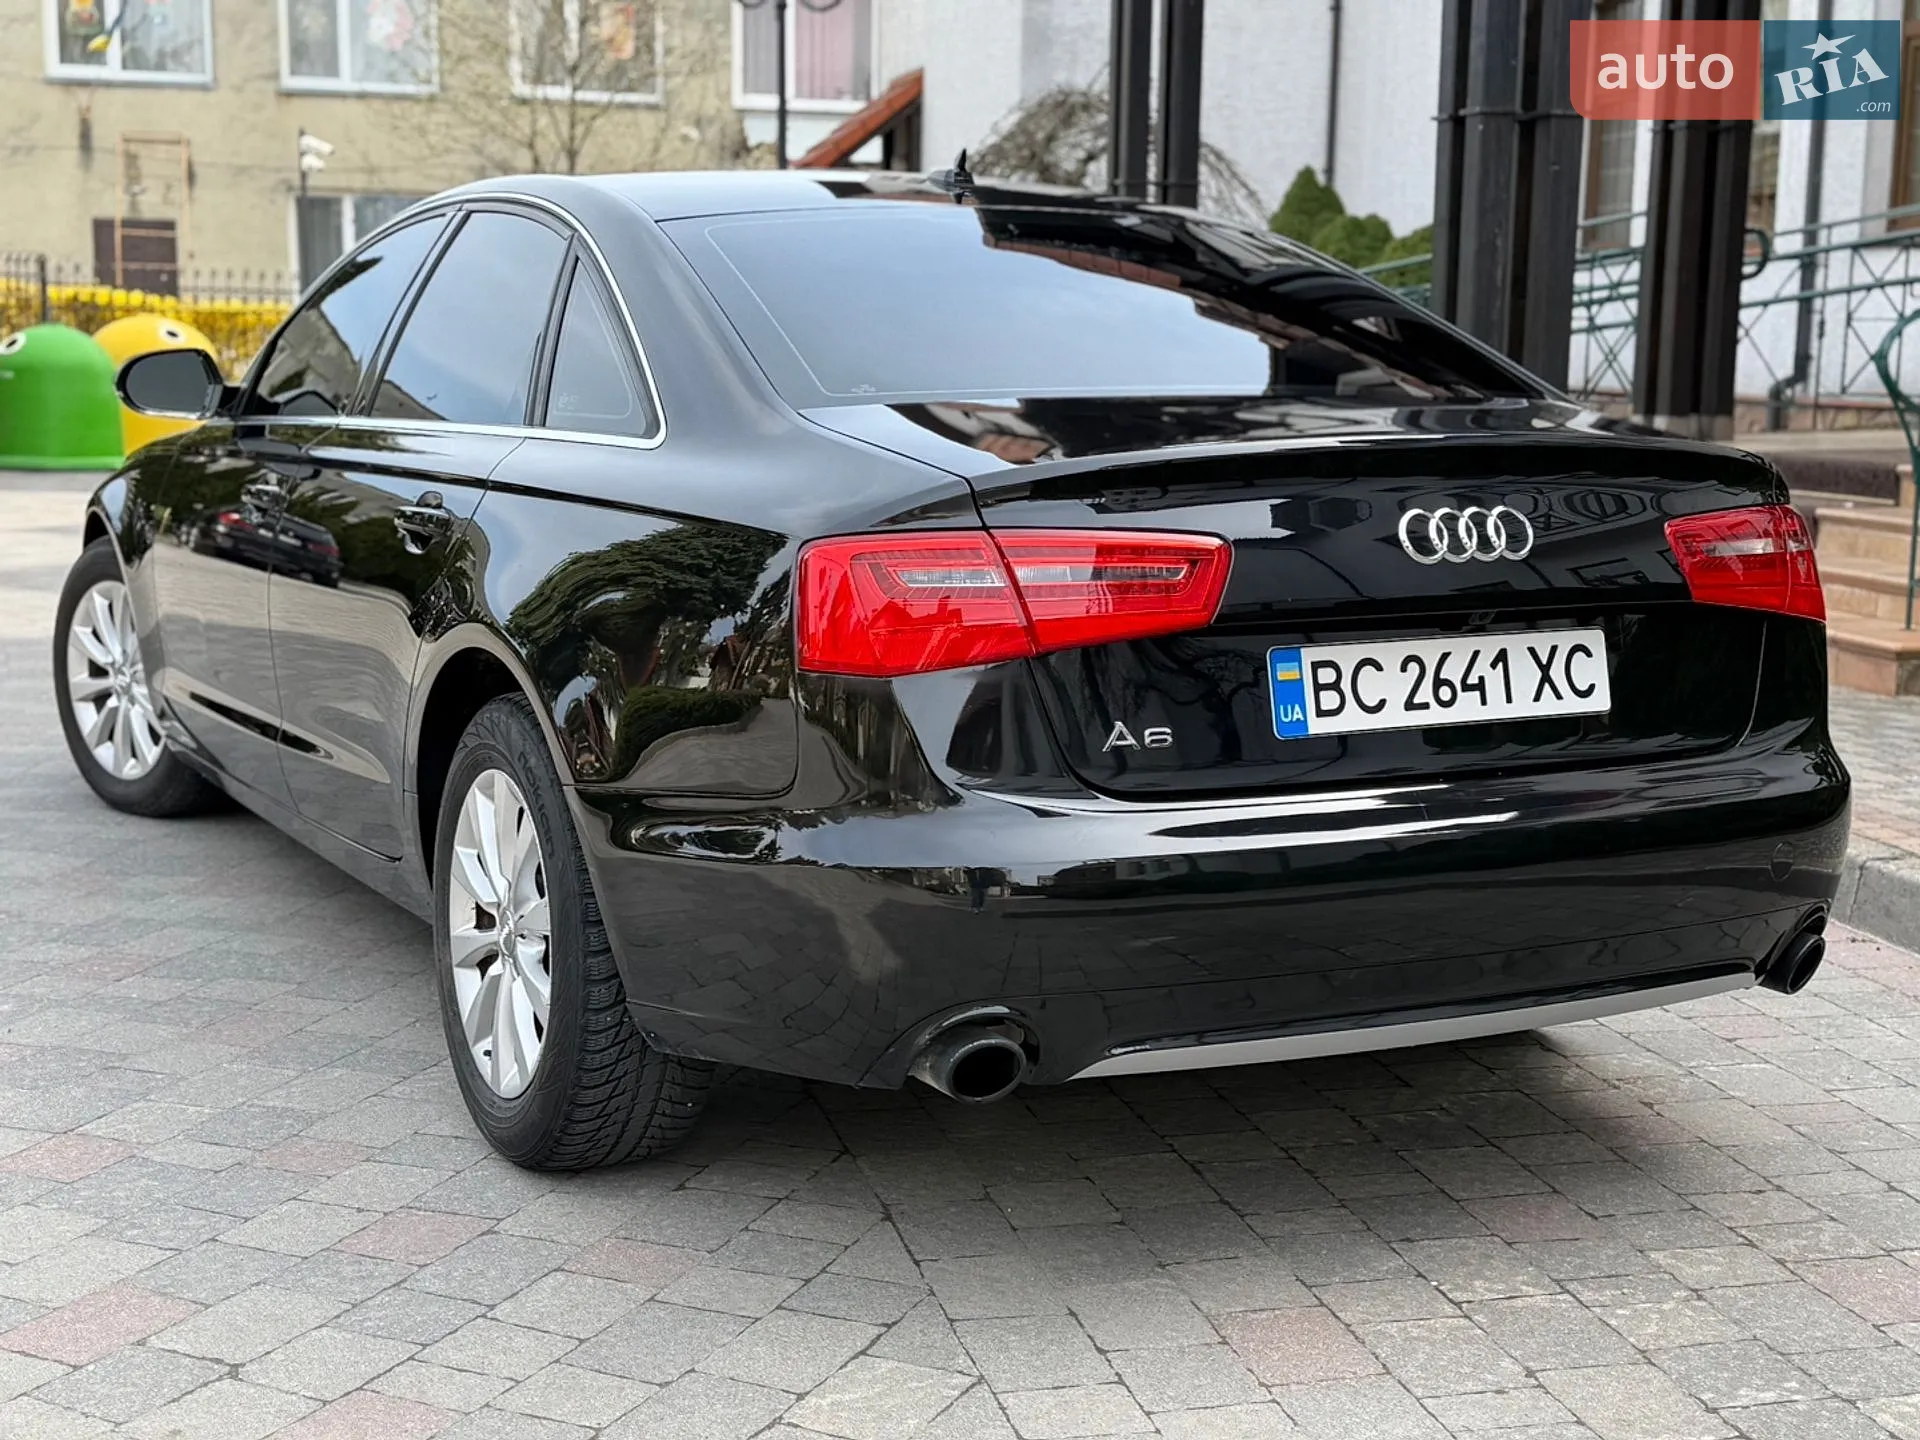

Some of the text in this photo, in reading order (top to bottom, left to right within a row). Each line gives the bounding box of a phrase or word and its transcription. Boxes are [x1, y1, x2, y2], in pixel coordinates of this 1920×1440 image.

[1310, 644, 1596, 718] BC 2641 XC
[1280, 703, 1304, 722] UA
[1102, 721, 1173, 752] A6
